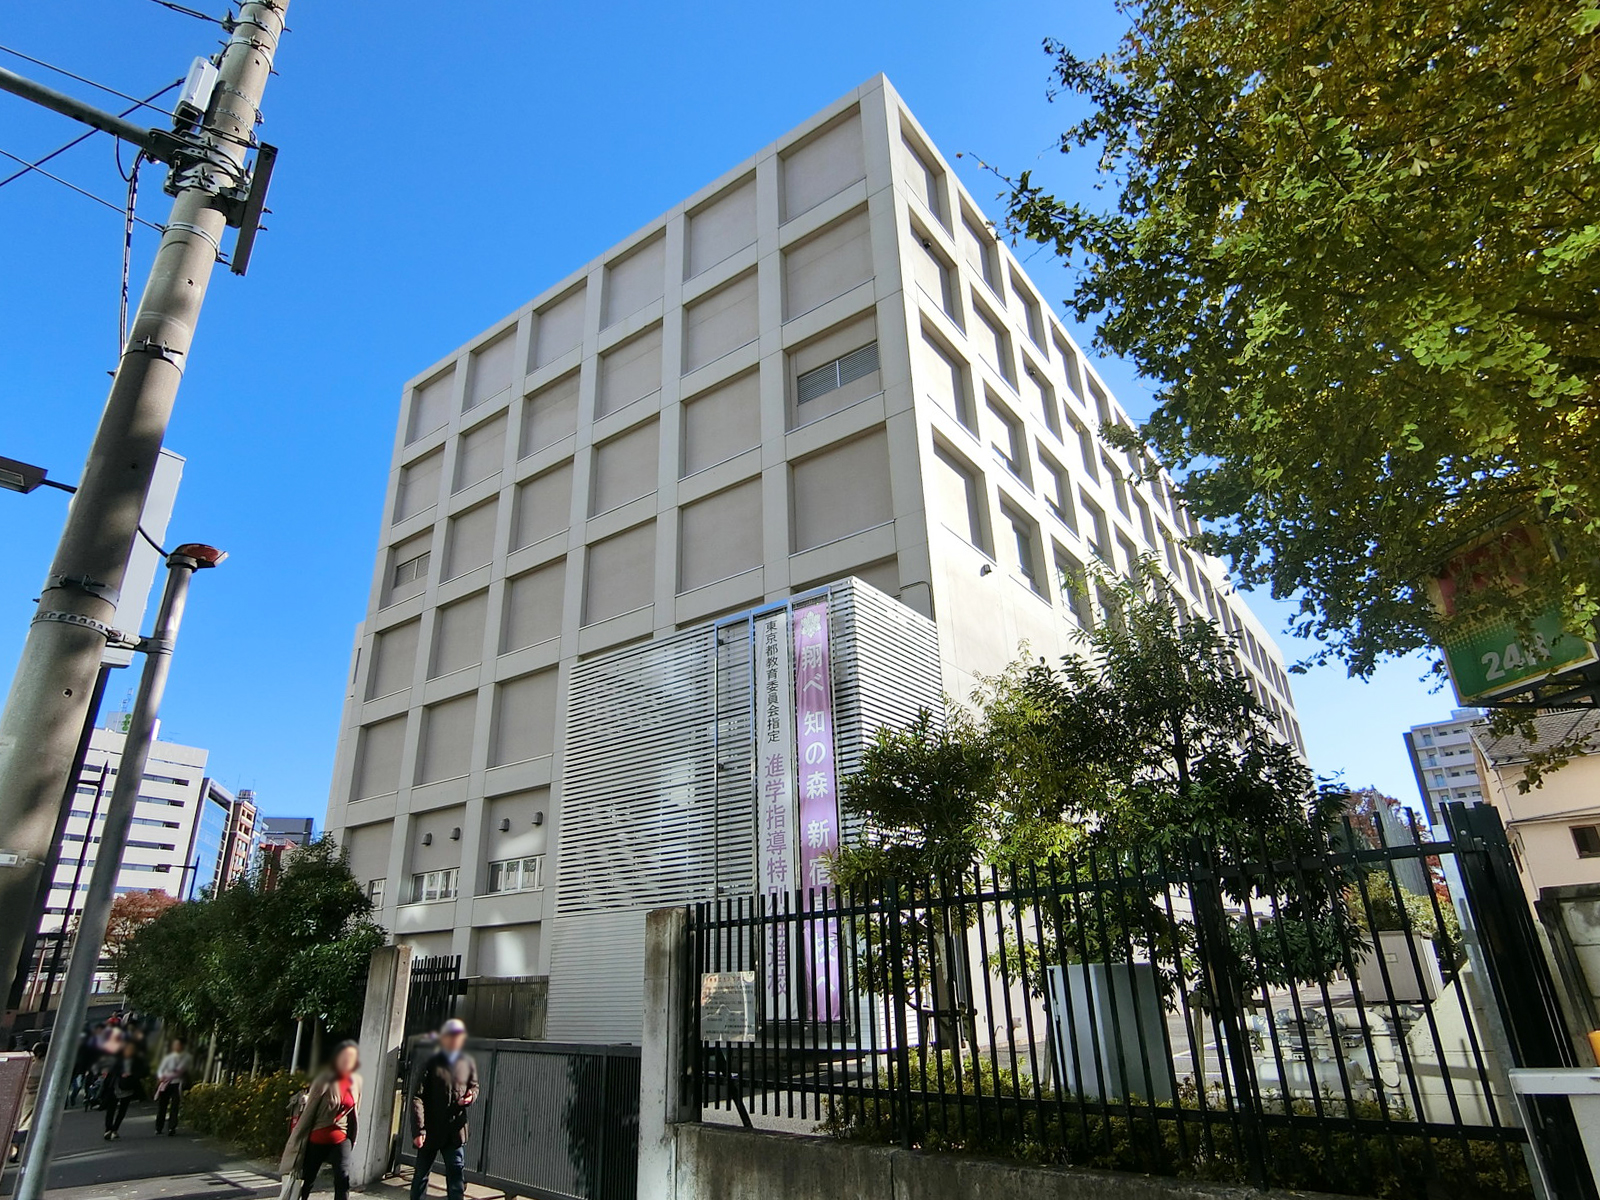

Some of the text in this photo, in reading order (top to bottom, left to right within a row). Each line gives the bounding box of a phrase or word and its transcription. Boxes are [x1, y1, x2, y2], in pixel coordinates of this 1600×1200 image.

[765, 620, 780, 744] 東京都教育委員会指定
[802, 643, 824, 692] 翔べ
[804, 710, 829, 799] 知の森
